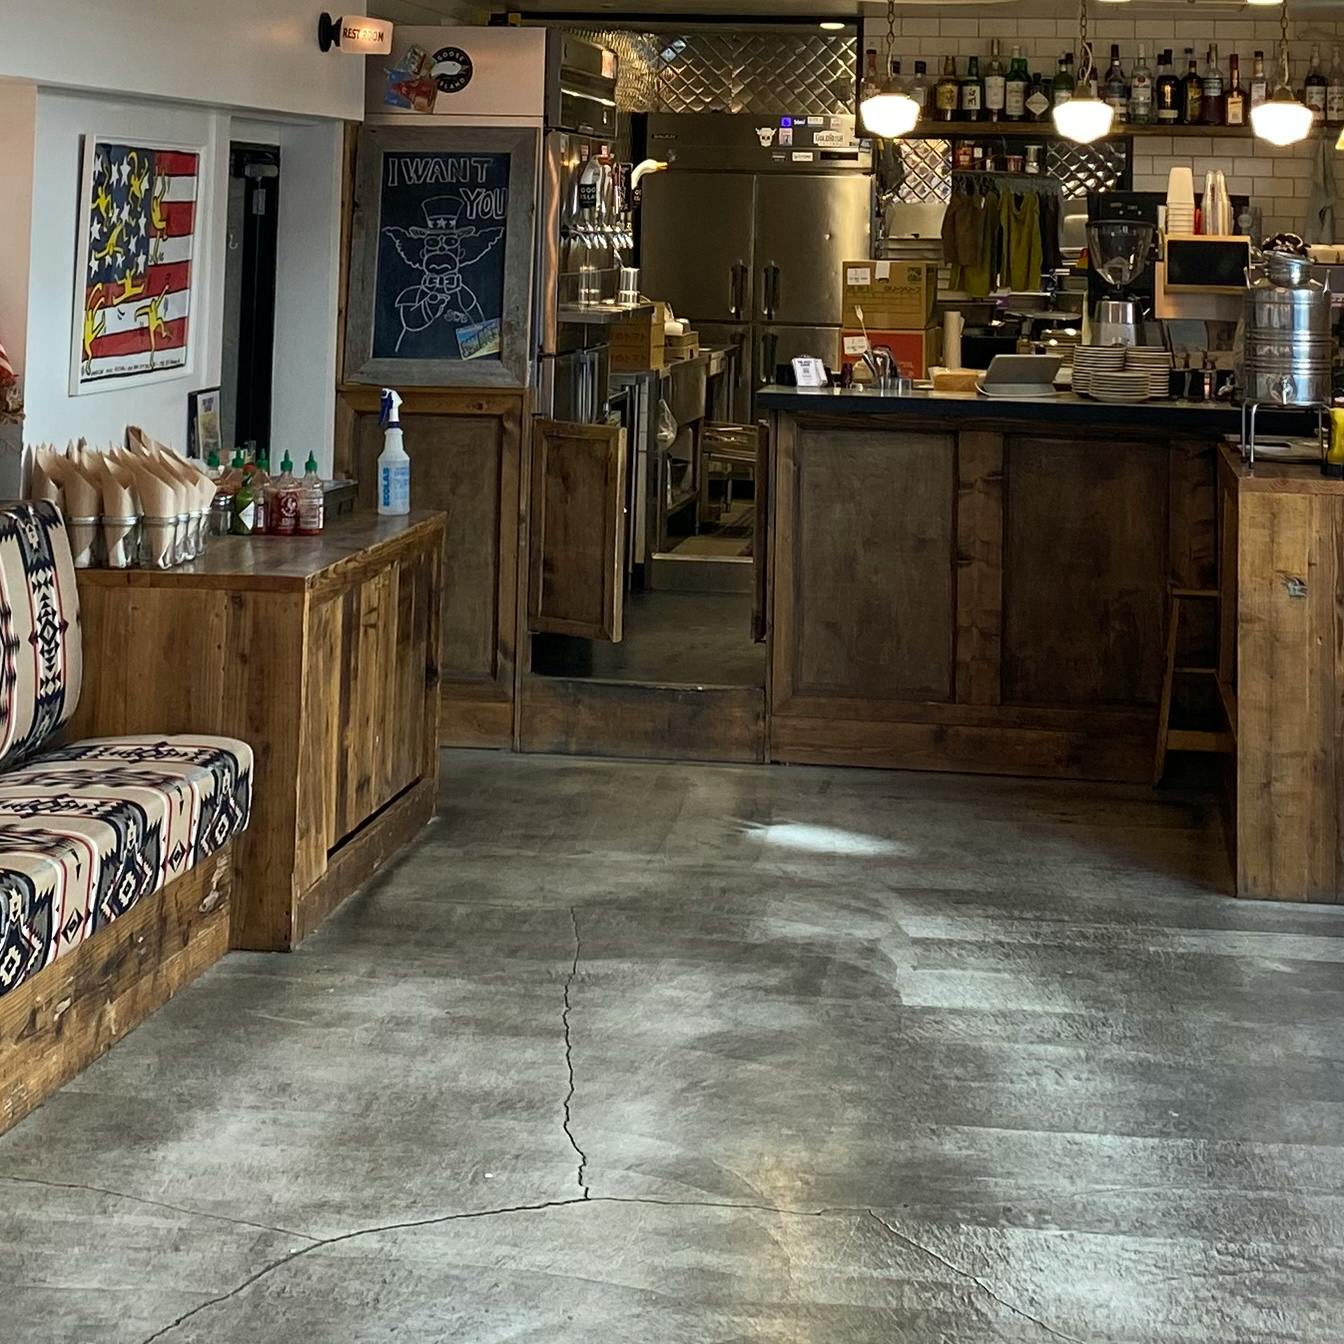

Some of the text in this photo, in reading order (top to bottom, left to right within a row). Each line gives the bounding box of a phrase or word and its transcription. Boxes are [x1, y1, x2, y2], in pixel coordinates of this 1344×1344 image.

[342, 27, 384, 43] REST ROOM
[437, 50, 465, 62] GOOSE
[387, 158, 493, 187] I WANT
[459, 187, 507, 220] YOU
